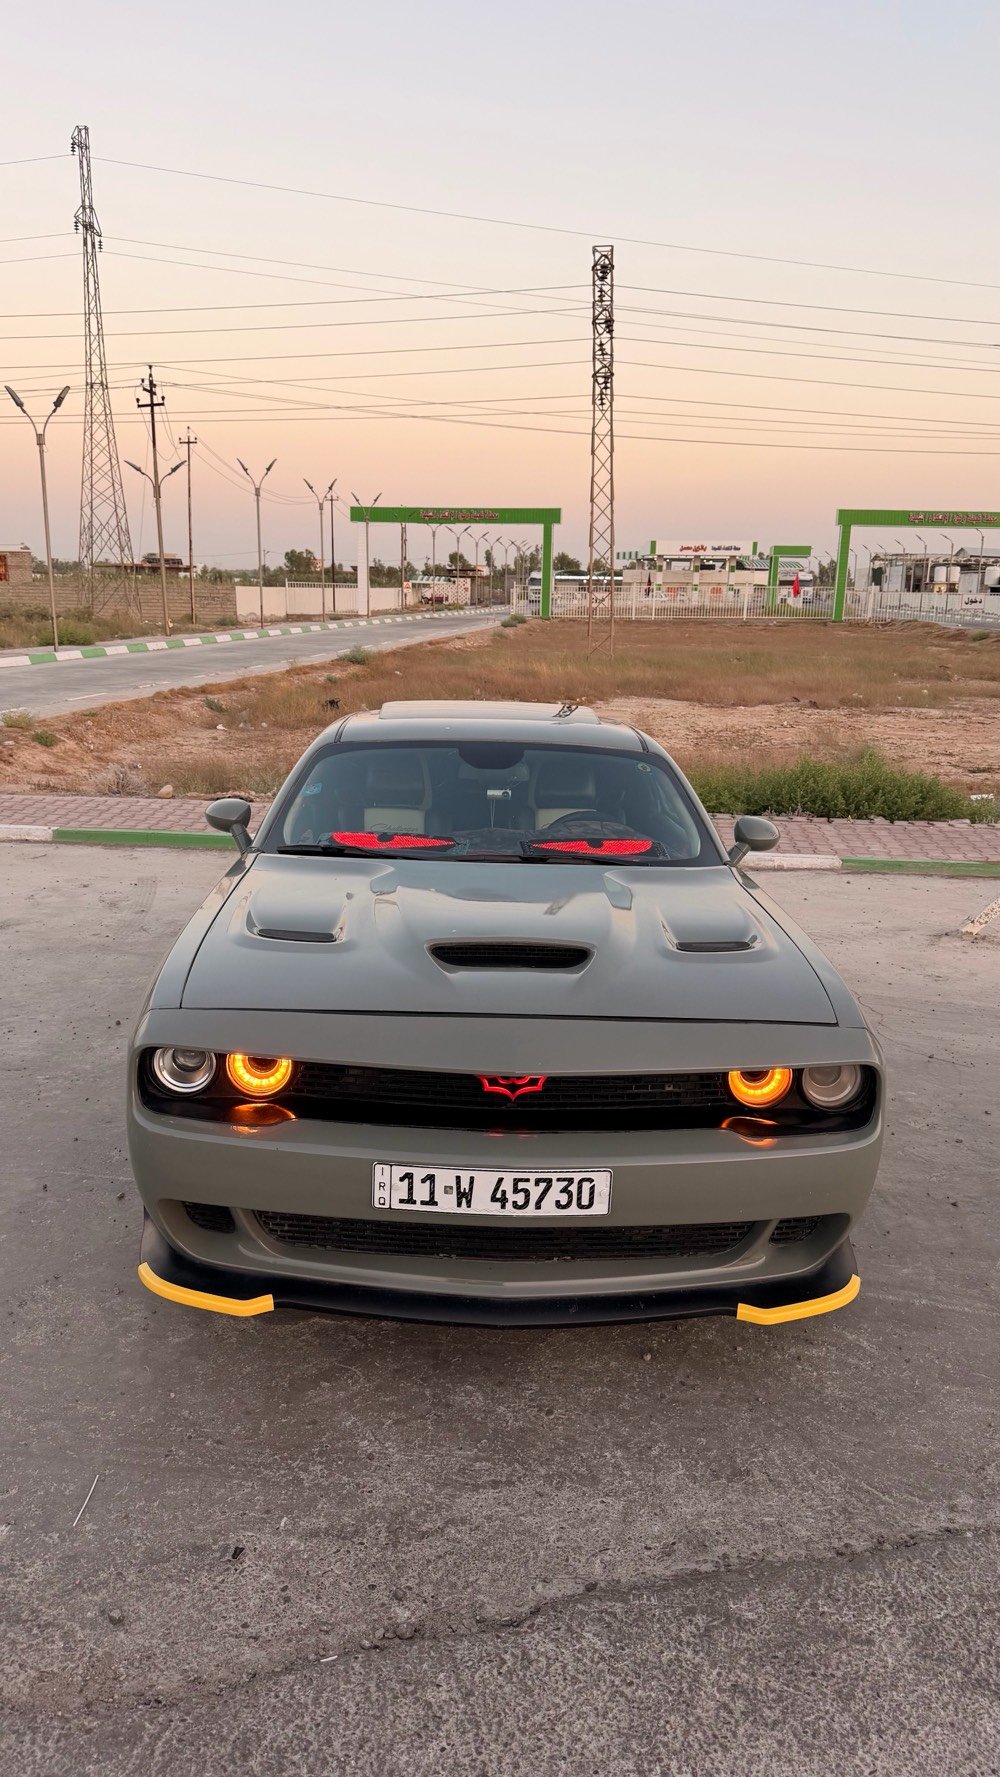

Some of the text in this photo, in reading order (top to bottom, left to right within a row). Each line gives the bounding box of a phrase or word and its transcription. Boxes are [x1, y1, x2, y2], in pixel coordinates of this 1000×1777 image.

[964, 597, 982, 605] دخول
[399, 1172, 595, 1210] 11 W 45730
